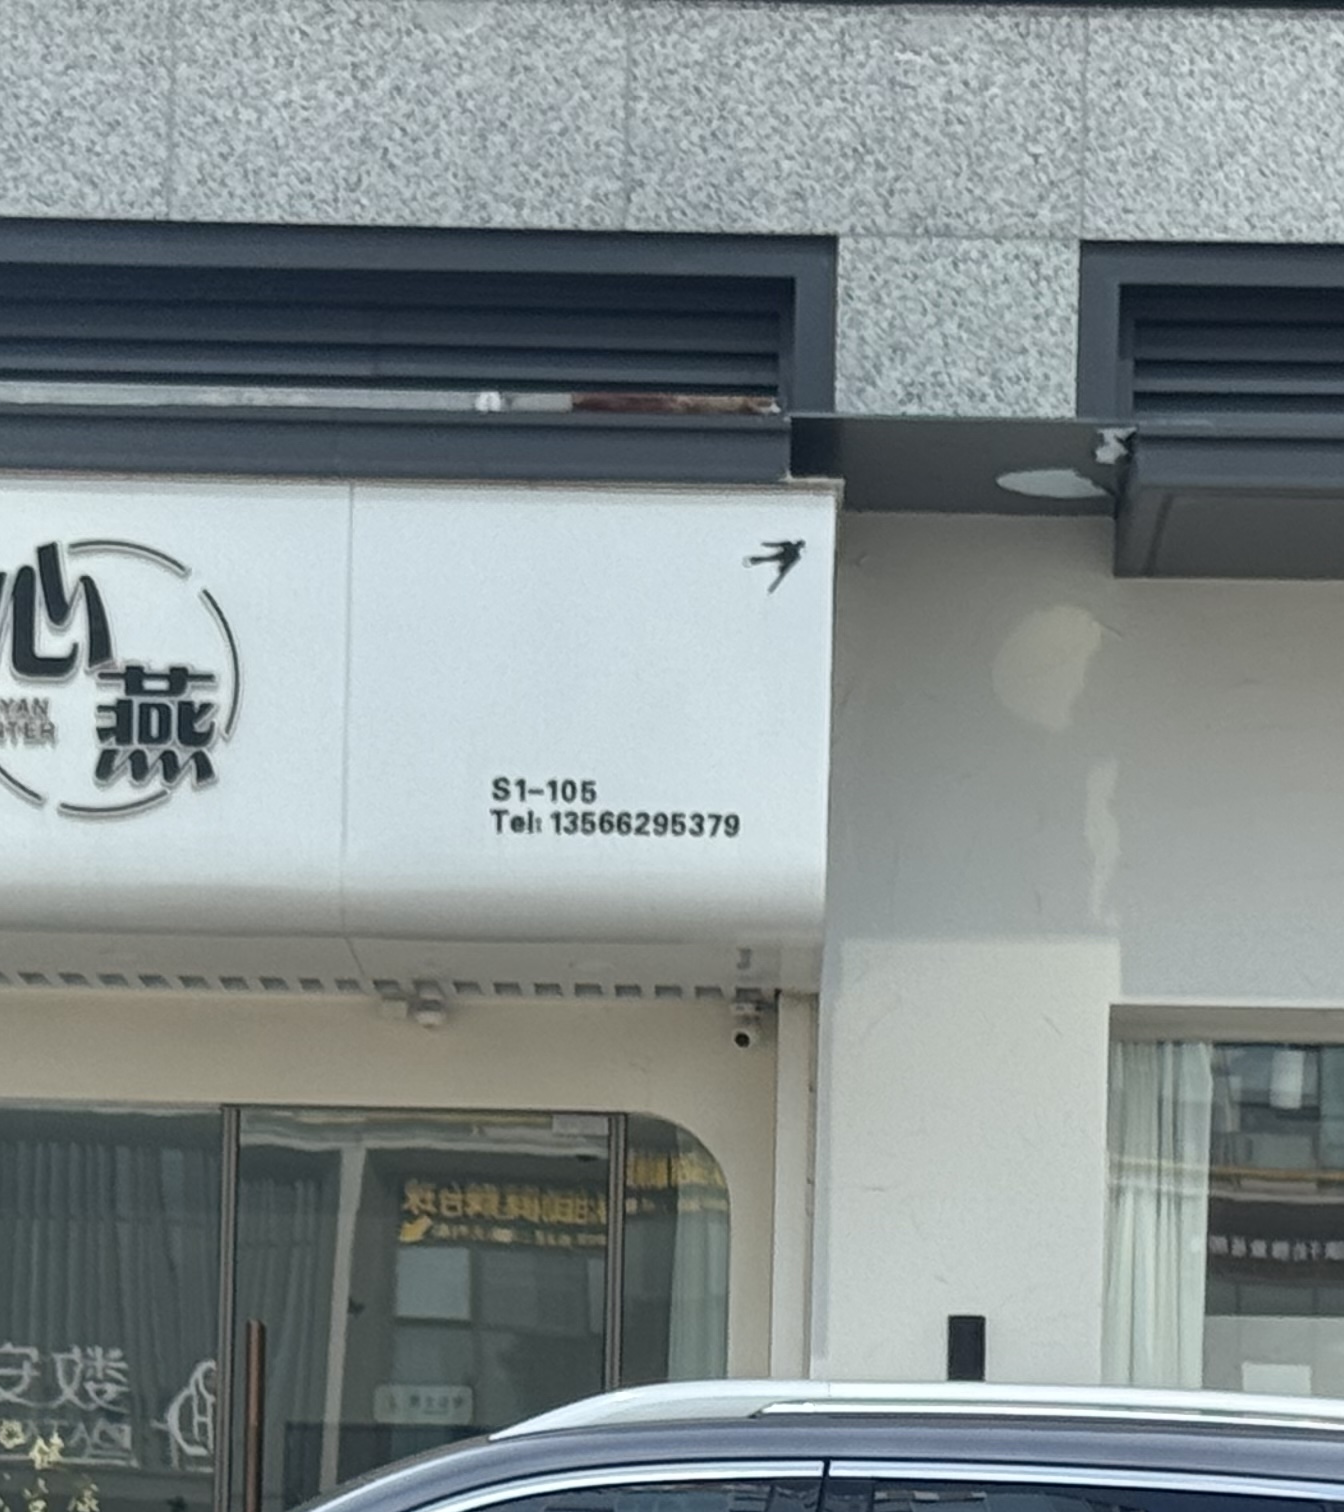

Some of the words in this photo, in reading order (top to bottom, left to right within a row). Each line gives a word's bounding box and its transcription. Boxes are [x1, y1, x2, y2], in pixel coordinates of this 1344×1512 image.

[490, 775, 598, 804] S1-105
[489, 808, 543, 835] Tel:
[549, 810, 741, 838] 13566295379
